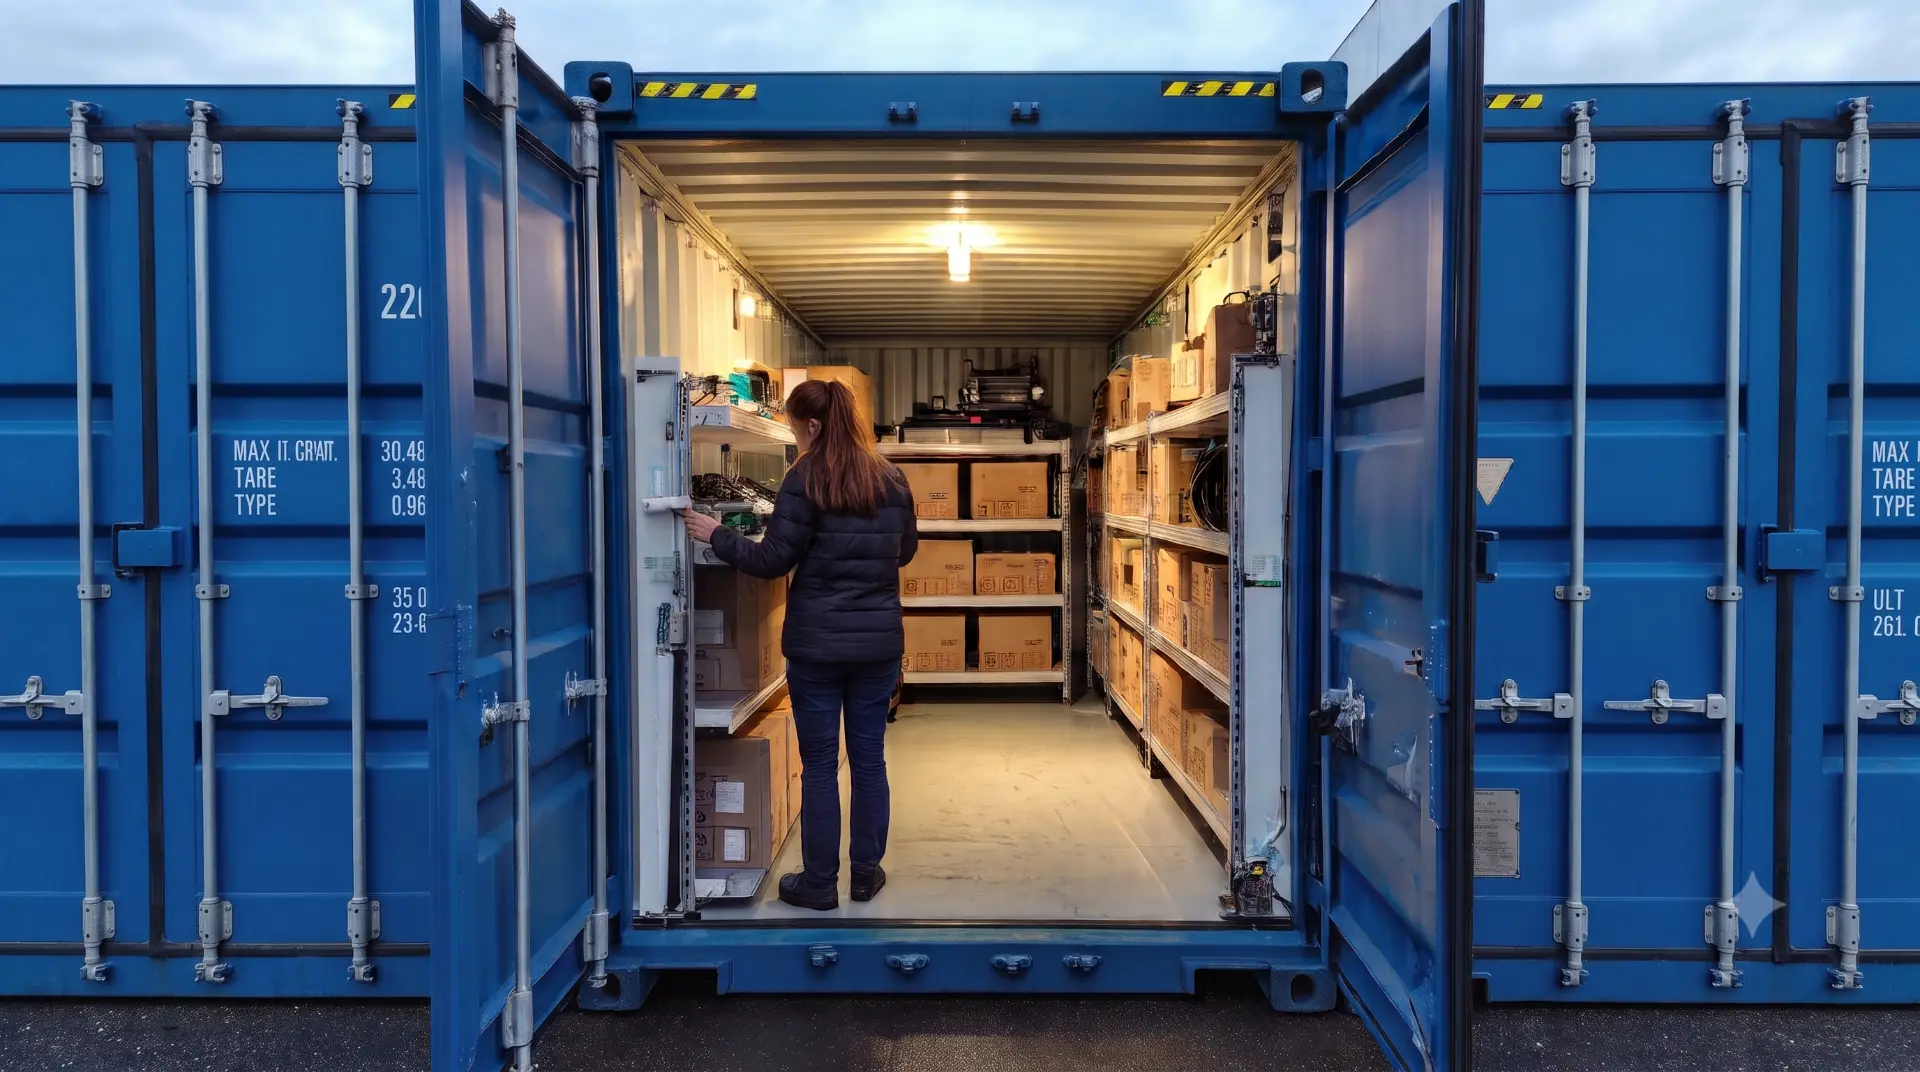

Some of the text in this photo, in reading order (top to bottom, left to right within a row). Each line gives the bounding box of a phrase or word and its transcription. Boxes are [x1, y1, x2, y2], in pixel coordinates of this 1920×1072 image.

[381, 283, 422, 319] 22
[234, 440, 270, 461] MAX
[1872, 440, 1909, 463] MAX
[234, 467, 276, 488] TARE
[1872, 468, 1915, 489] TARE
[234, 494, 276, 515] TYPE
[1872, 495, 1915, 517] TYPE
[1873, 589, 1905, 610] ULT
